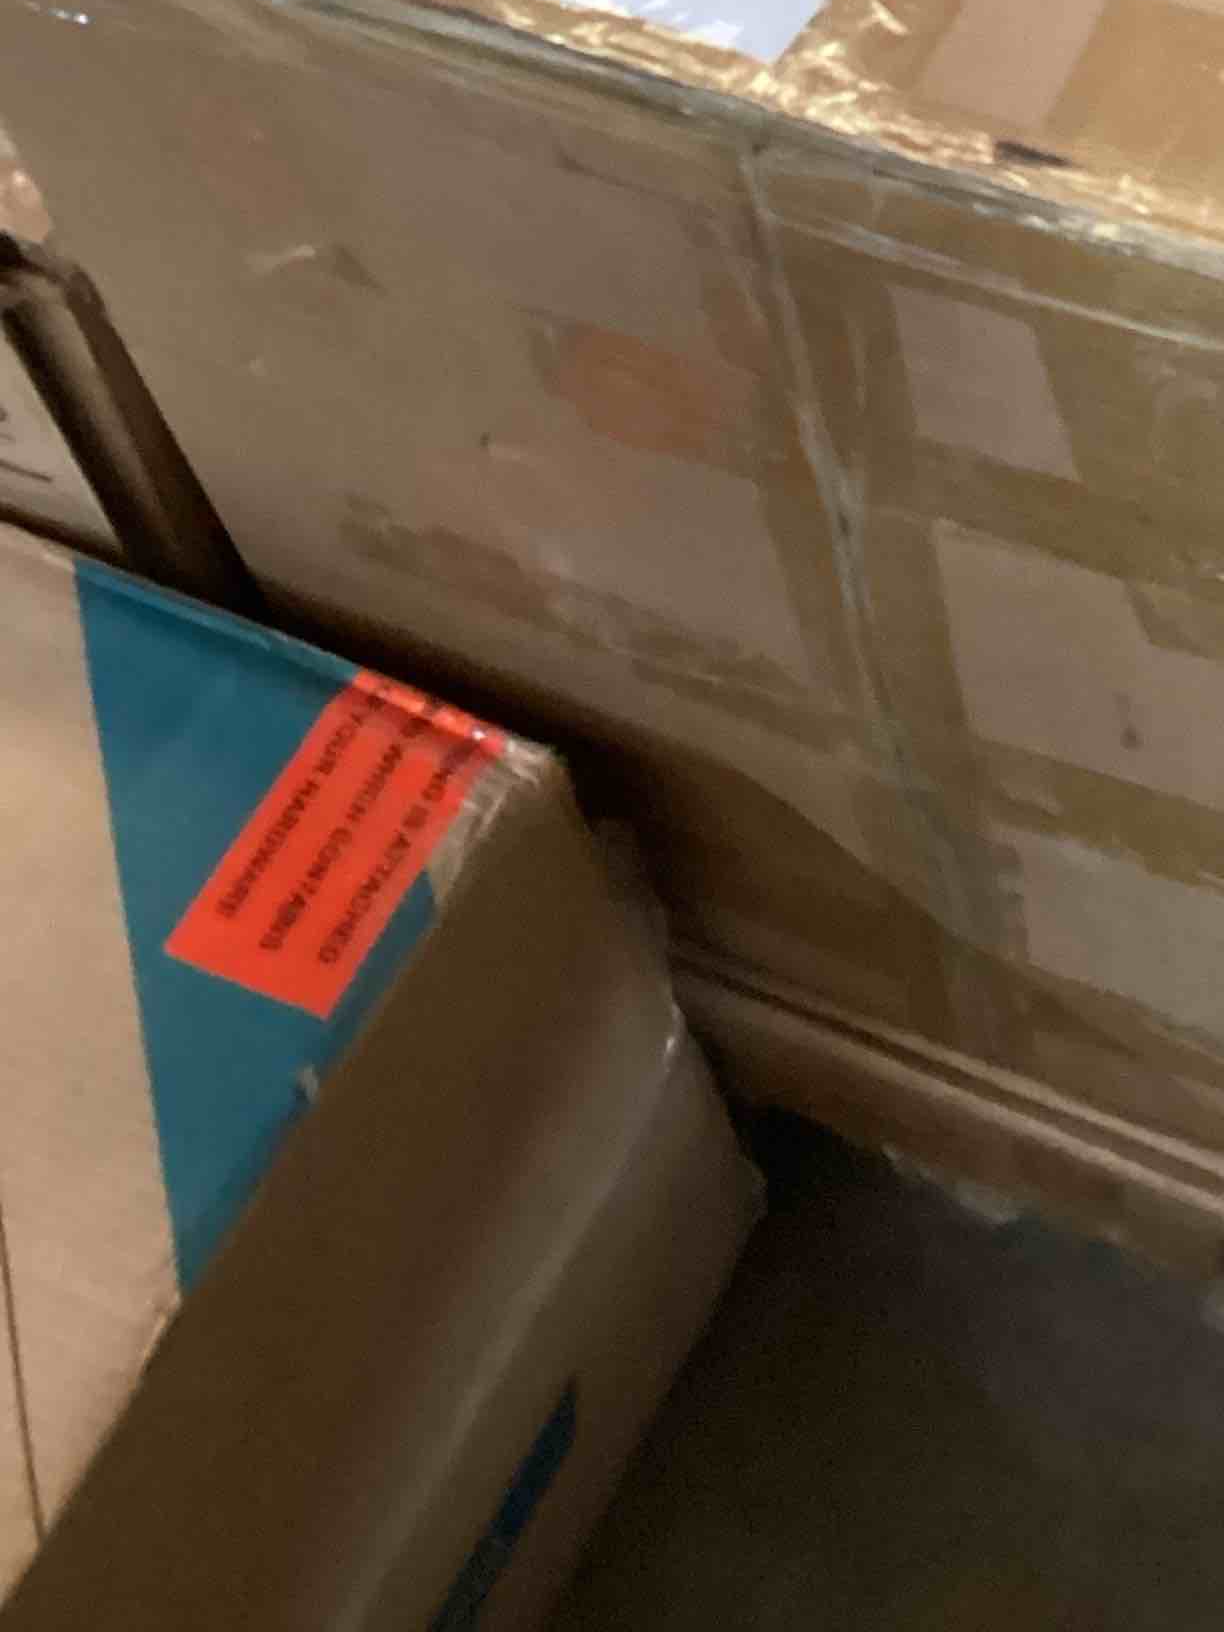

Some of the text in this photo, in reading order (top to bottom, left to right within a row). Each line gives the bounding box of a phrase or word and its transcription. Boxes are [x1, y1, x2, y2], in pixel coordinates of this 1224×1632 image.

[214, 710, 366, 921] YOUR HARDWARE
[258, 825, 355, 953] CONTAINS
[317, 830, 413, 966] ATTACHED
